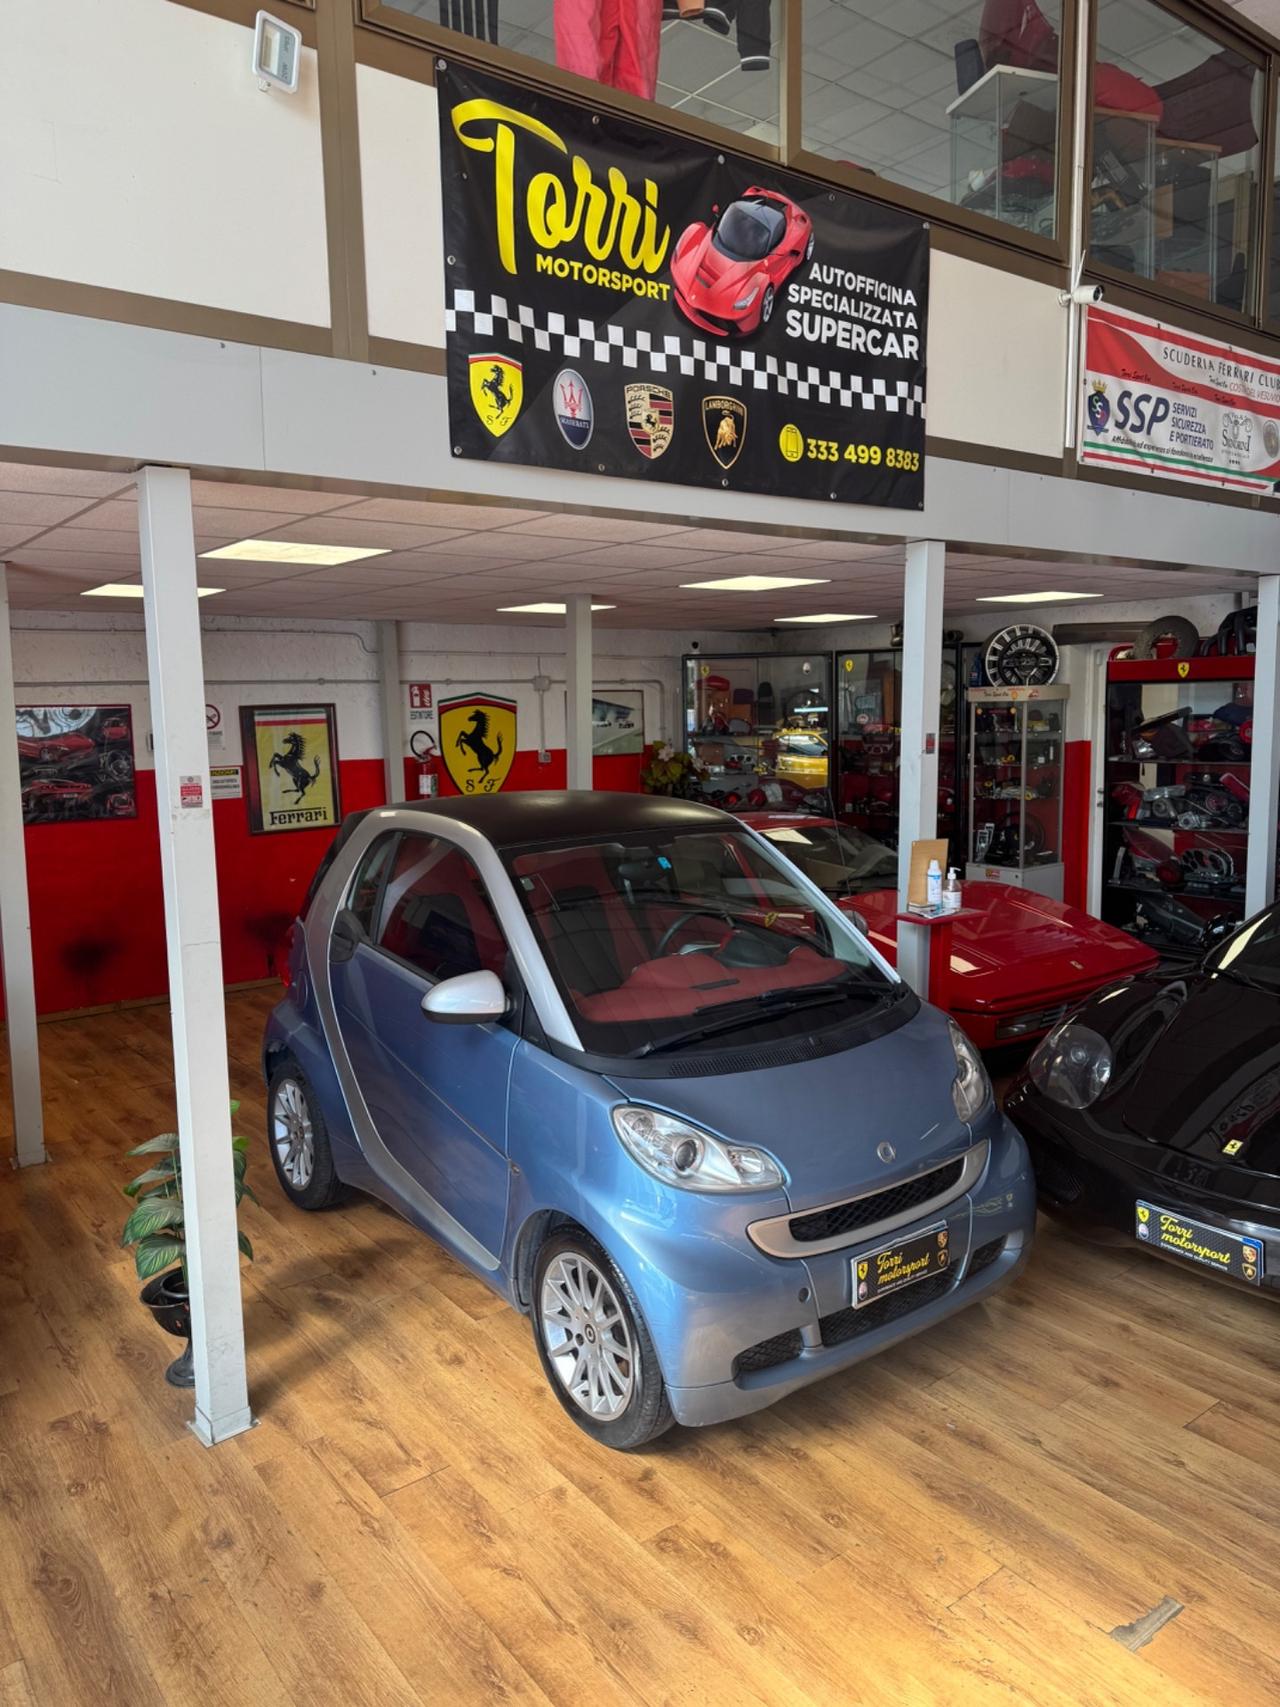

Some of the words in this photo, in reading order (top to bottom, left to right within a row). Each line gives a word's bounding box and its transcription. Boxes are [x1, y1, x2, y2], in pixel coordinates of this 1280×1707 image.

[451, 98, 671, 275] Torri
[535, 253, 671, 301] MOTORSPORT
[808, 262, 918, 307] AUTOFFICINA
[787, 283, 919, 330] SPECIALIZZATA
[785, 309, 919, 361] SUPERCAR
[1162, 346, 1215, 372] SCUDERIA
[1218, 361, 1255, 384] FERRARI
[1114, 390, 1170, 436] SSP
[1171, 417, 1206, 435] SICUREZZA
[1172, 402, 1198, 418] SERVIZI
[807, 438, 840, 462] 333
[844, 444, 882, 465] 499
[885, 448, 920, 472] 8383
[1169, 431, 1175, 442] E
[1175, 433, 1214, 451] PORTIERATO
[466, 779, 475, 793] S
[268, 807, 329, 825] Ferrari
[1160, 1214, 1193, 1239] Torri
[877, 1251, 903, 1273] Torri
[1161, 1232, 1231, 1264] motorsport
[877, 1252, 930, 1285] motorsport
